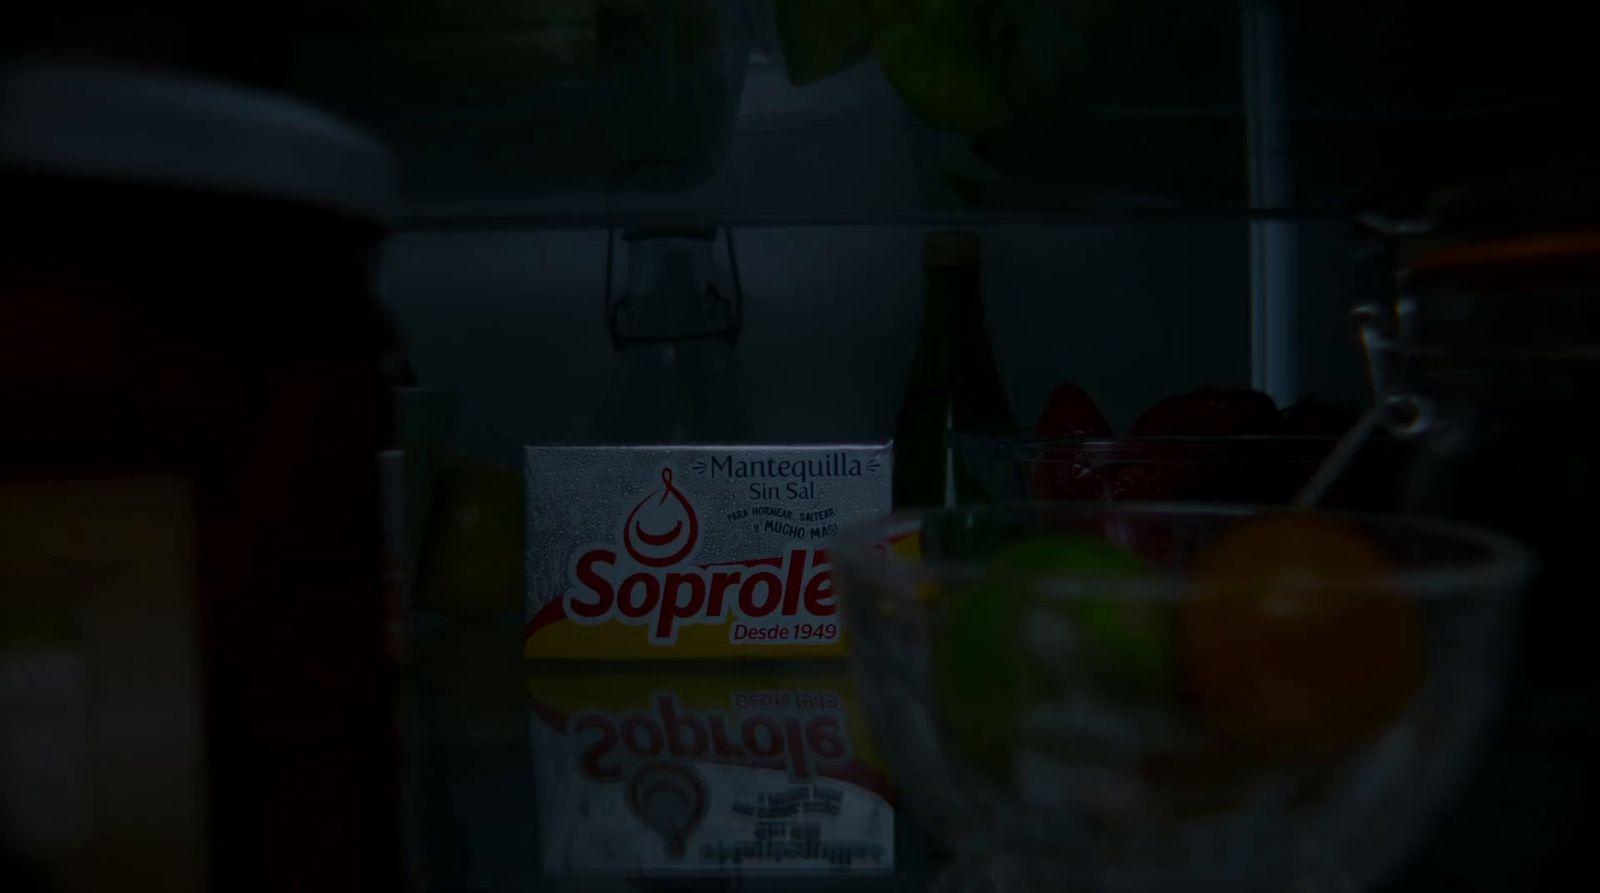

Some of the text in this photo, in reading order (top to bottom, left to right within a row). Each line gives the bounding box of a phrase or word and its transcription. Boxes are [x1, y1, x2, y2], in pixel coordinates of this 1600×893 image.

[711, 452, 862, 482] Mantequilla
[750, 481, 814, 500] Sin Sal
[727, 508, 749, 522] PARA
[764, 520, 805, 539] MUCHO
[570, 549, 837, 638] Soprole
[734, 624, 837, 640] Desde 1949
